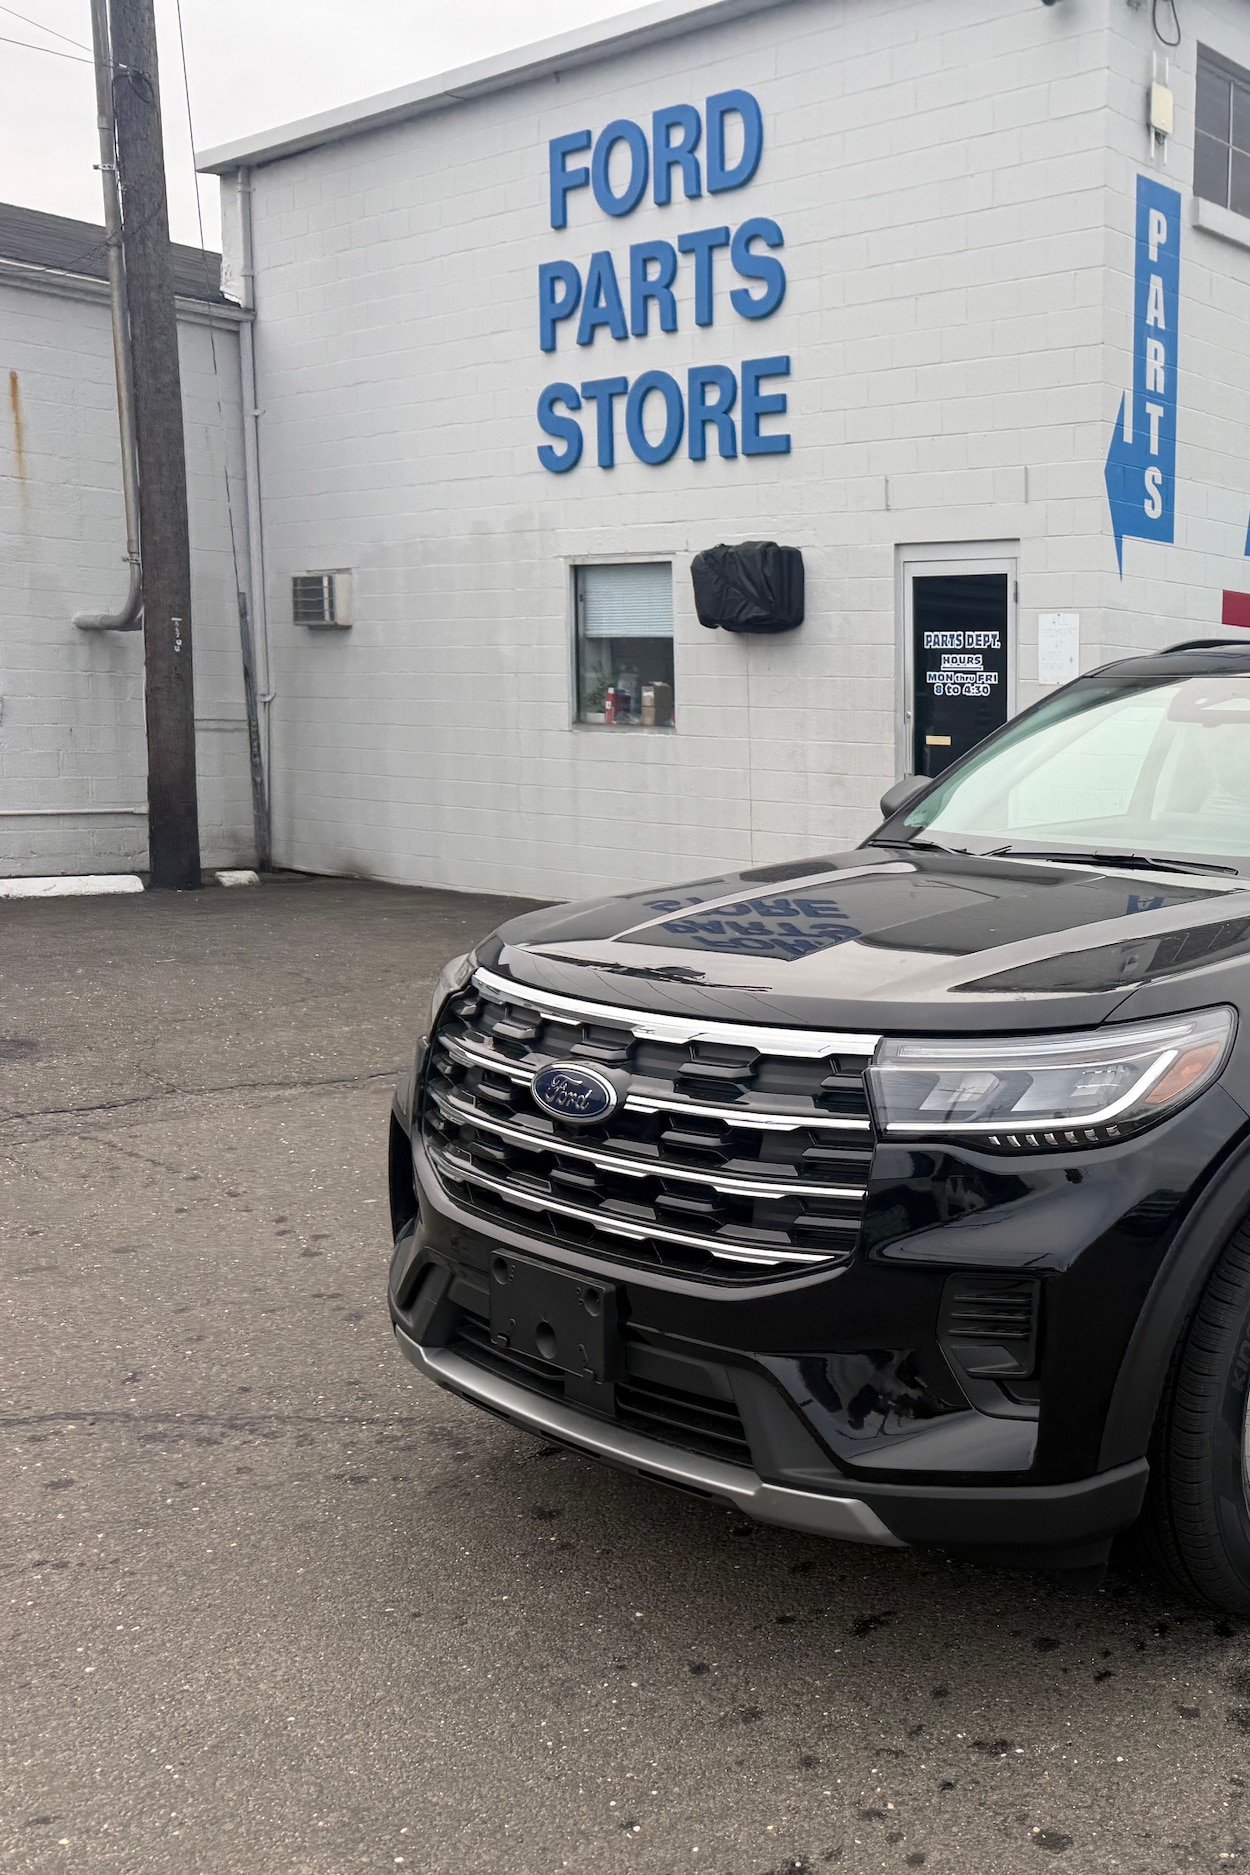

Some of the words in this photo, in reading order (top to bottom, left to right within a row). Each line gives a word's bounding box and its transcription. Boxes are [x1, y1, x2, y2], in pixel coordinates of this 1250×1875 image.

[549, 89, 763, 230] FORD
[538, 217, 787, 353] PARTS
[1144, 207, 1168, 520] PARTS
[537, 355, 791, 474] STORE
[924, 631, 964, 649] PARTS
[965, 631, 1001, 649] DEPT.
[927, 672, 954, 683] MON
[954, 673, 976, 683] thru
[976, 672, 998, 684] FRI
[941, 654, 983, 666] HOURS
[934, 683, 943, 696] 8
[945, 683, 961, 696] to
[962, 683, 991, 696] 4:30
[545, 1074, 593, 1110] Ford
